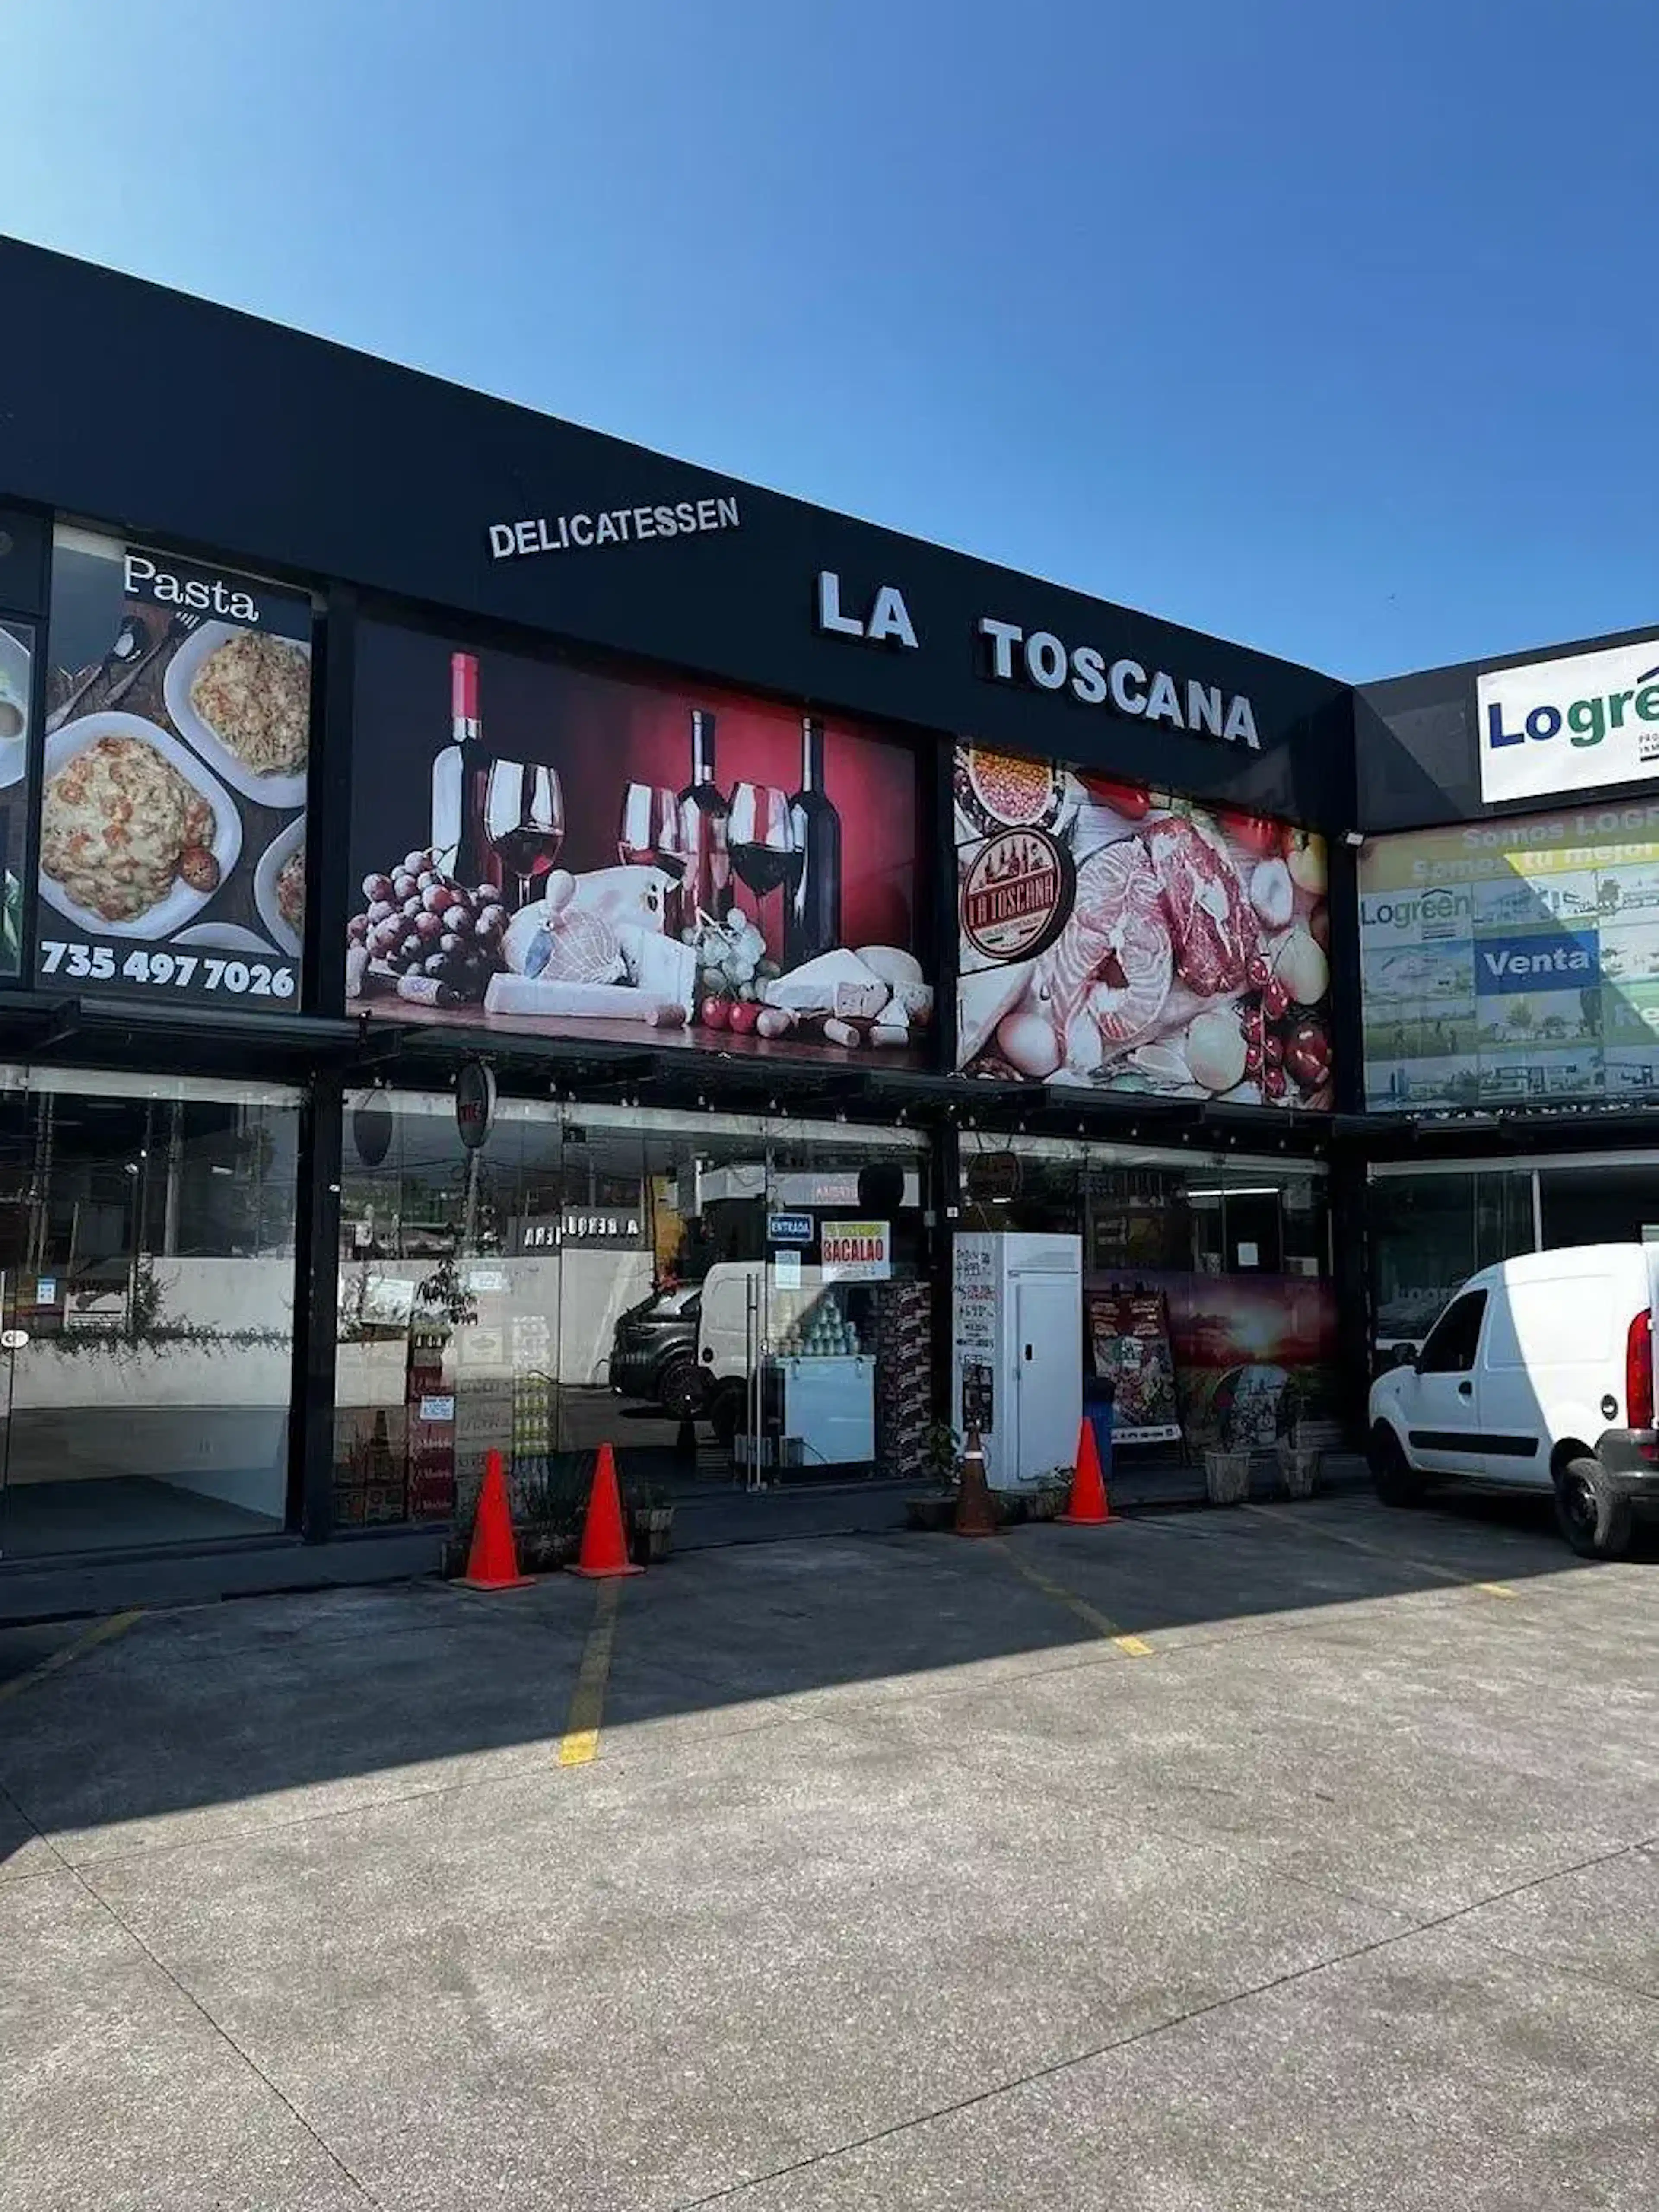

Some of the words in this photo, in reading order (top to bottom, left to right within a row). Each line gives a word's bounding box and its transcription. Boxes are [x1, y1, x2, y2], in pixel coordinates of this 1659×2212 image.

[489, 496, 741, 558] DELICATESSEN
[124, 555, 260, 622] Pasta
[818, 571, 919, 648] LA
[979, 617, 1261, 750] TOSCANA
[1462, 823, 1564, 849] Somos
[990, 873, 1054, 920] TOSCANA
[1361, 895, 1470, 929] Logreen
[41, 941, 116, 978] 735
[123, 952, 199, 988] 497
[203, 959, 295, 998] 7026
[1483, 947, 1592, 977] Venta
[771, 1221, 810, 1233] ENTRADA
[823, 1239, 884, 1262] BACALAO
